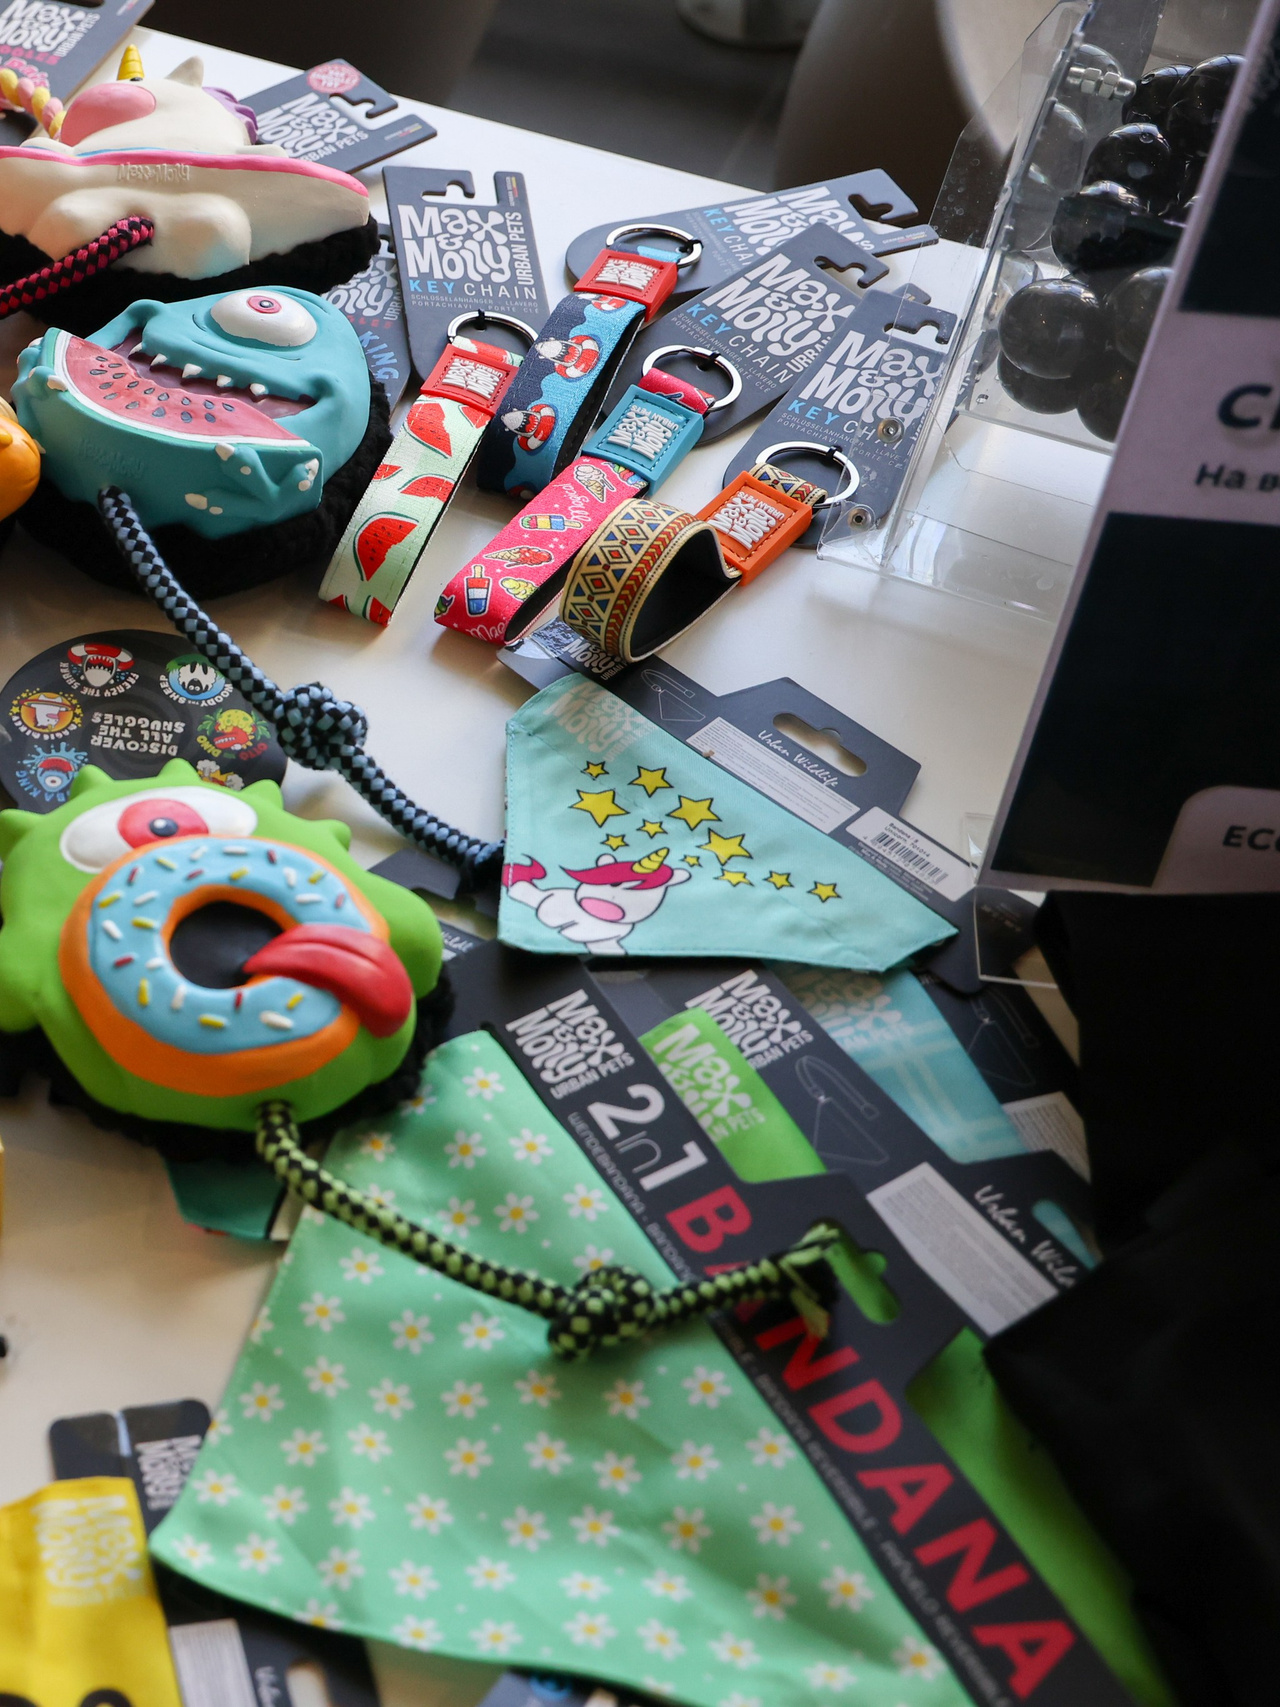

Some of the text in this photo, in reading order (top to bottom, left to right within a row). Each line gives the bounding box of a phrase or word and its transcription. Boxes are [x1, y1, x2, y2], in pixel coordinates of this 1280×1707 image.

[1, 0, 86, 29] Max
[254, 107, 325, 158] Molly
[281, 92, 361, 143] Max
[336, 130, 370, 153] PETS
[397, 204, 509, 246] Max
[703, 207, 736, 233] KEY
[403, 236, 512, 284] Molly
[505, 211, 536, 286] URBAN PETS
[320, 281, 394, 317] olly
[408, 279, 538, 301] KEY CHAIN
[744, 252, 856, 333] Max
[702, 276, 822, 357] Molly
[686, 303, 795, 385] KEY CHAIN
[749, 366, 778, 389] LLAVERO
[826, 330, 942, 398] Max
[787, 399, 840, 426] KEY
[798, 362, 929, 428] Molly
[607, 411, 651, 449] Max
[630, 403, 680, 432] URBAN PETS
[776, 418, 839, 445] PORTACHIAVI
[631, 419, 673, 461] Molly
[1195, 463, 1247, 489] На
[707, 497, 756, 535] Max
[737, 491, 786, 520] URBAN PETS
[728, 507, 777, 551] Molly
[562, 638, 616, 674] Molly
[600, 664, 626, 681] URBAN
[80, 686, 102, 698] THE
[103, 672, 140, 698] FRENZY
[158, 674, 234, 708] WOODY SHEEP
[48, 722, 79, 741] MAGIC
[90, 711, 186, 734] SNUGGLES
[98, 724, 174, 744] ALL THE
[542, 690, 625, 753] Molly
[90, 734, 179, 757] DISCOVER
[196, 734, 269, 761] OTTO DINO
[757, 729, 839, 788] Urban Wildlife
[15, 769, 43, 798] KING
[720, 968, 803, 1044] Max
[505, 1006, 590, 1084] Molly
[547, 988, 625, 1068] Max
[780, 1028, 815, 1055] PETS
[549, 1051, 636, 1100] URBAN PETS
[652, 1022, 754, 1118] Max
[586, 1083, 665, 1141] 2
[613, 1130, 662, 1174] in
[638, 1140, 709, 1193] 1
[973, 1183, 1027, 1244] Urban
